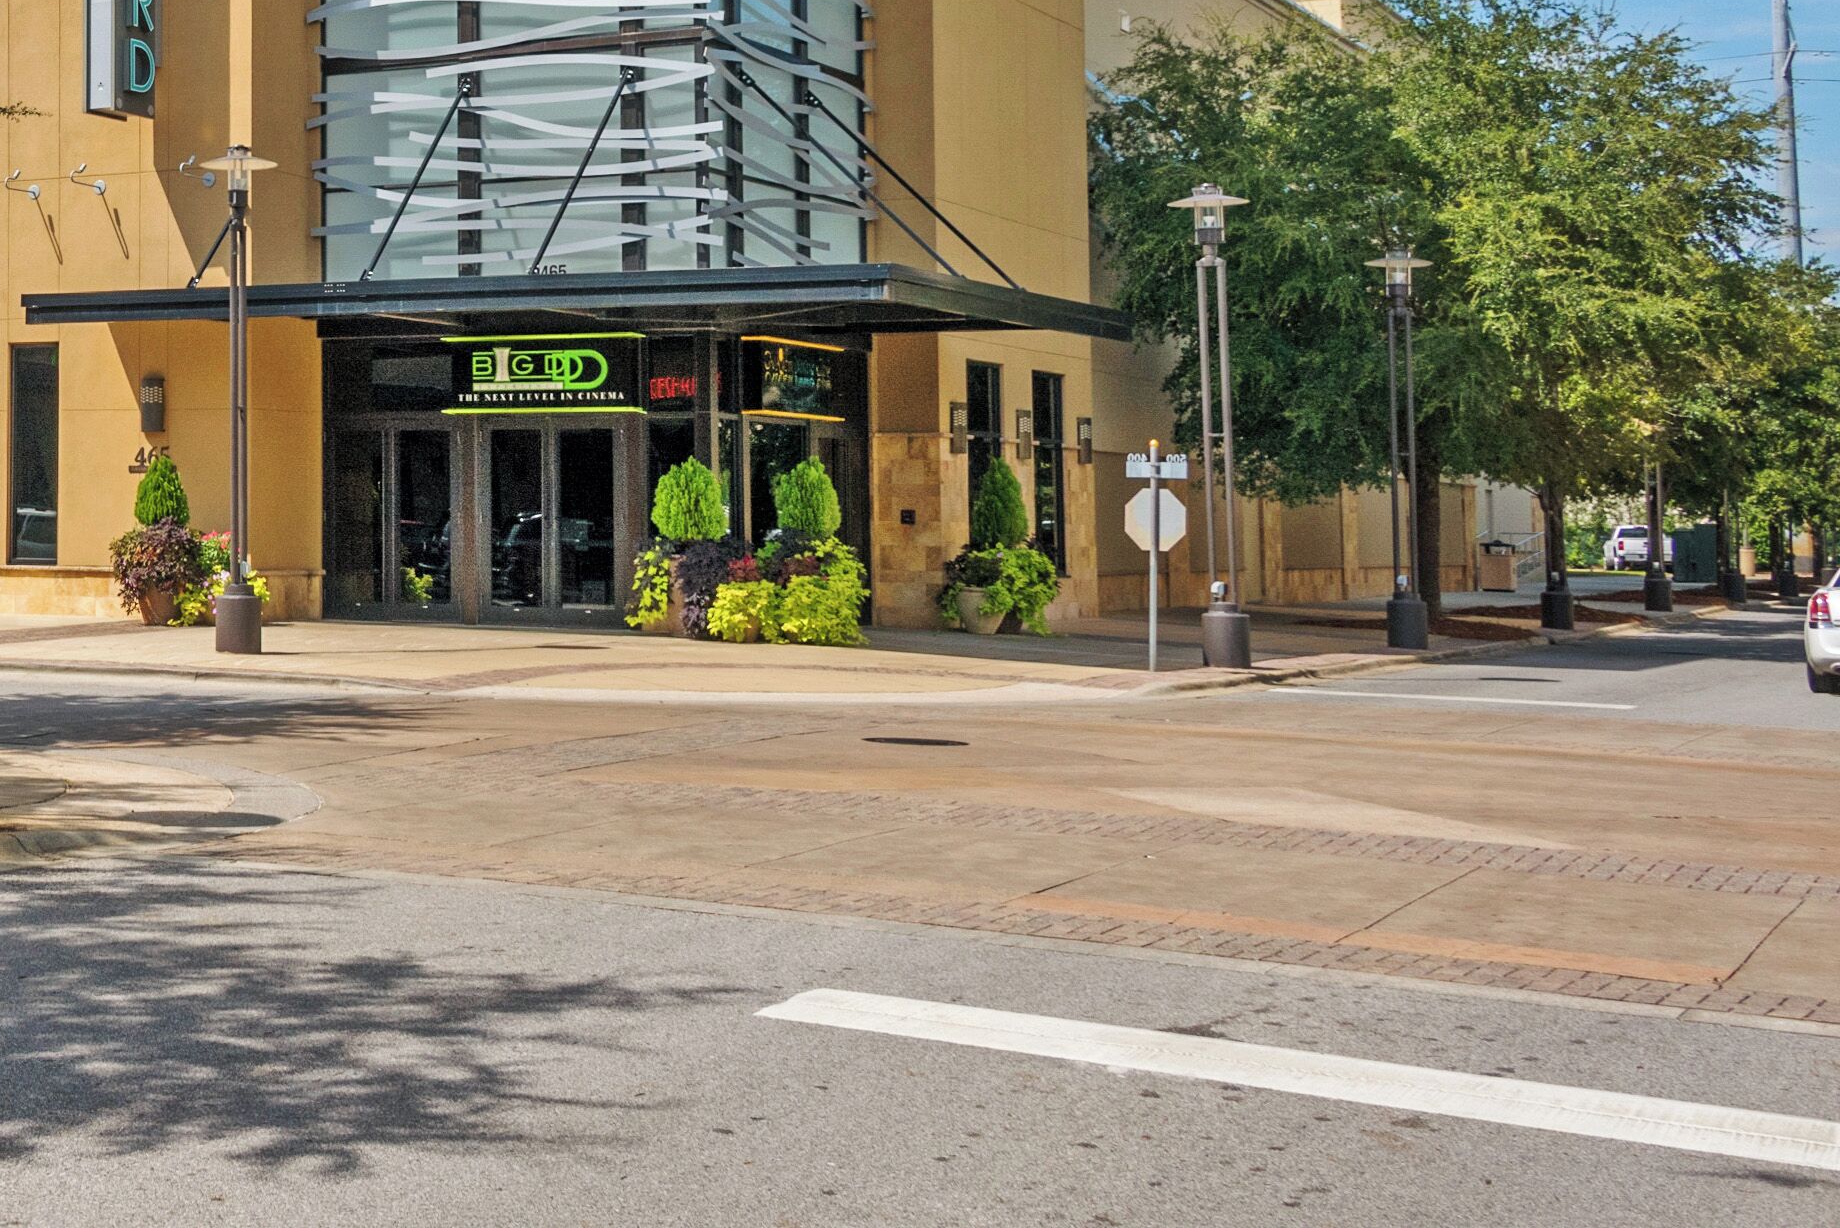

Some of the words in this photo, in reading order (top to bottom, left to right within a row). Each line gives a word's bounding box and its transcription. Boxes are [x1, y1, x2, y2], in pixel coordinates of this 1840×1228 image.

[458, 394, 480, 402] THE
[484, 393, 514, 402] NEXT
[519, 392, 556, 401] LEVEL
[560, 392, 573, 400] IN
[578, 391, 625, 400] CINEMA
